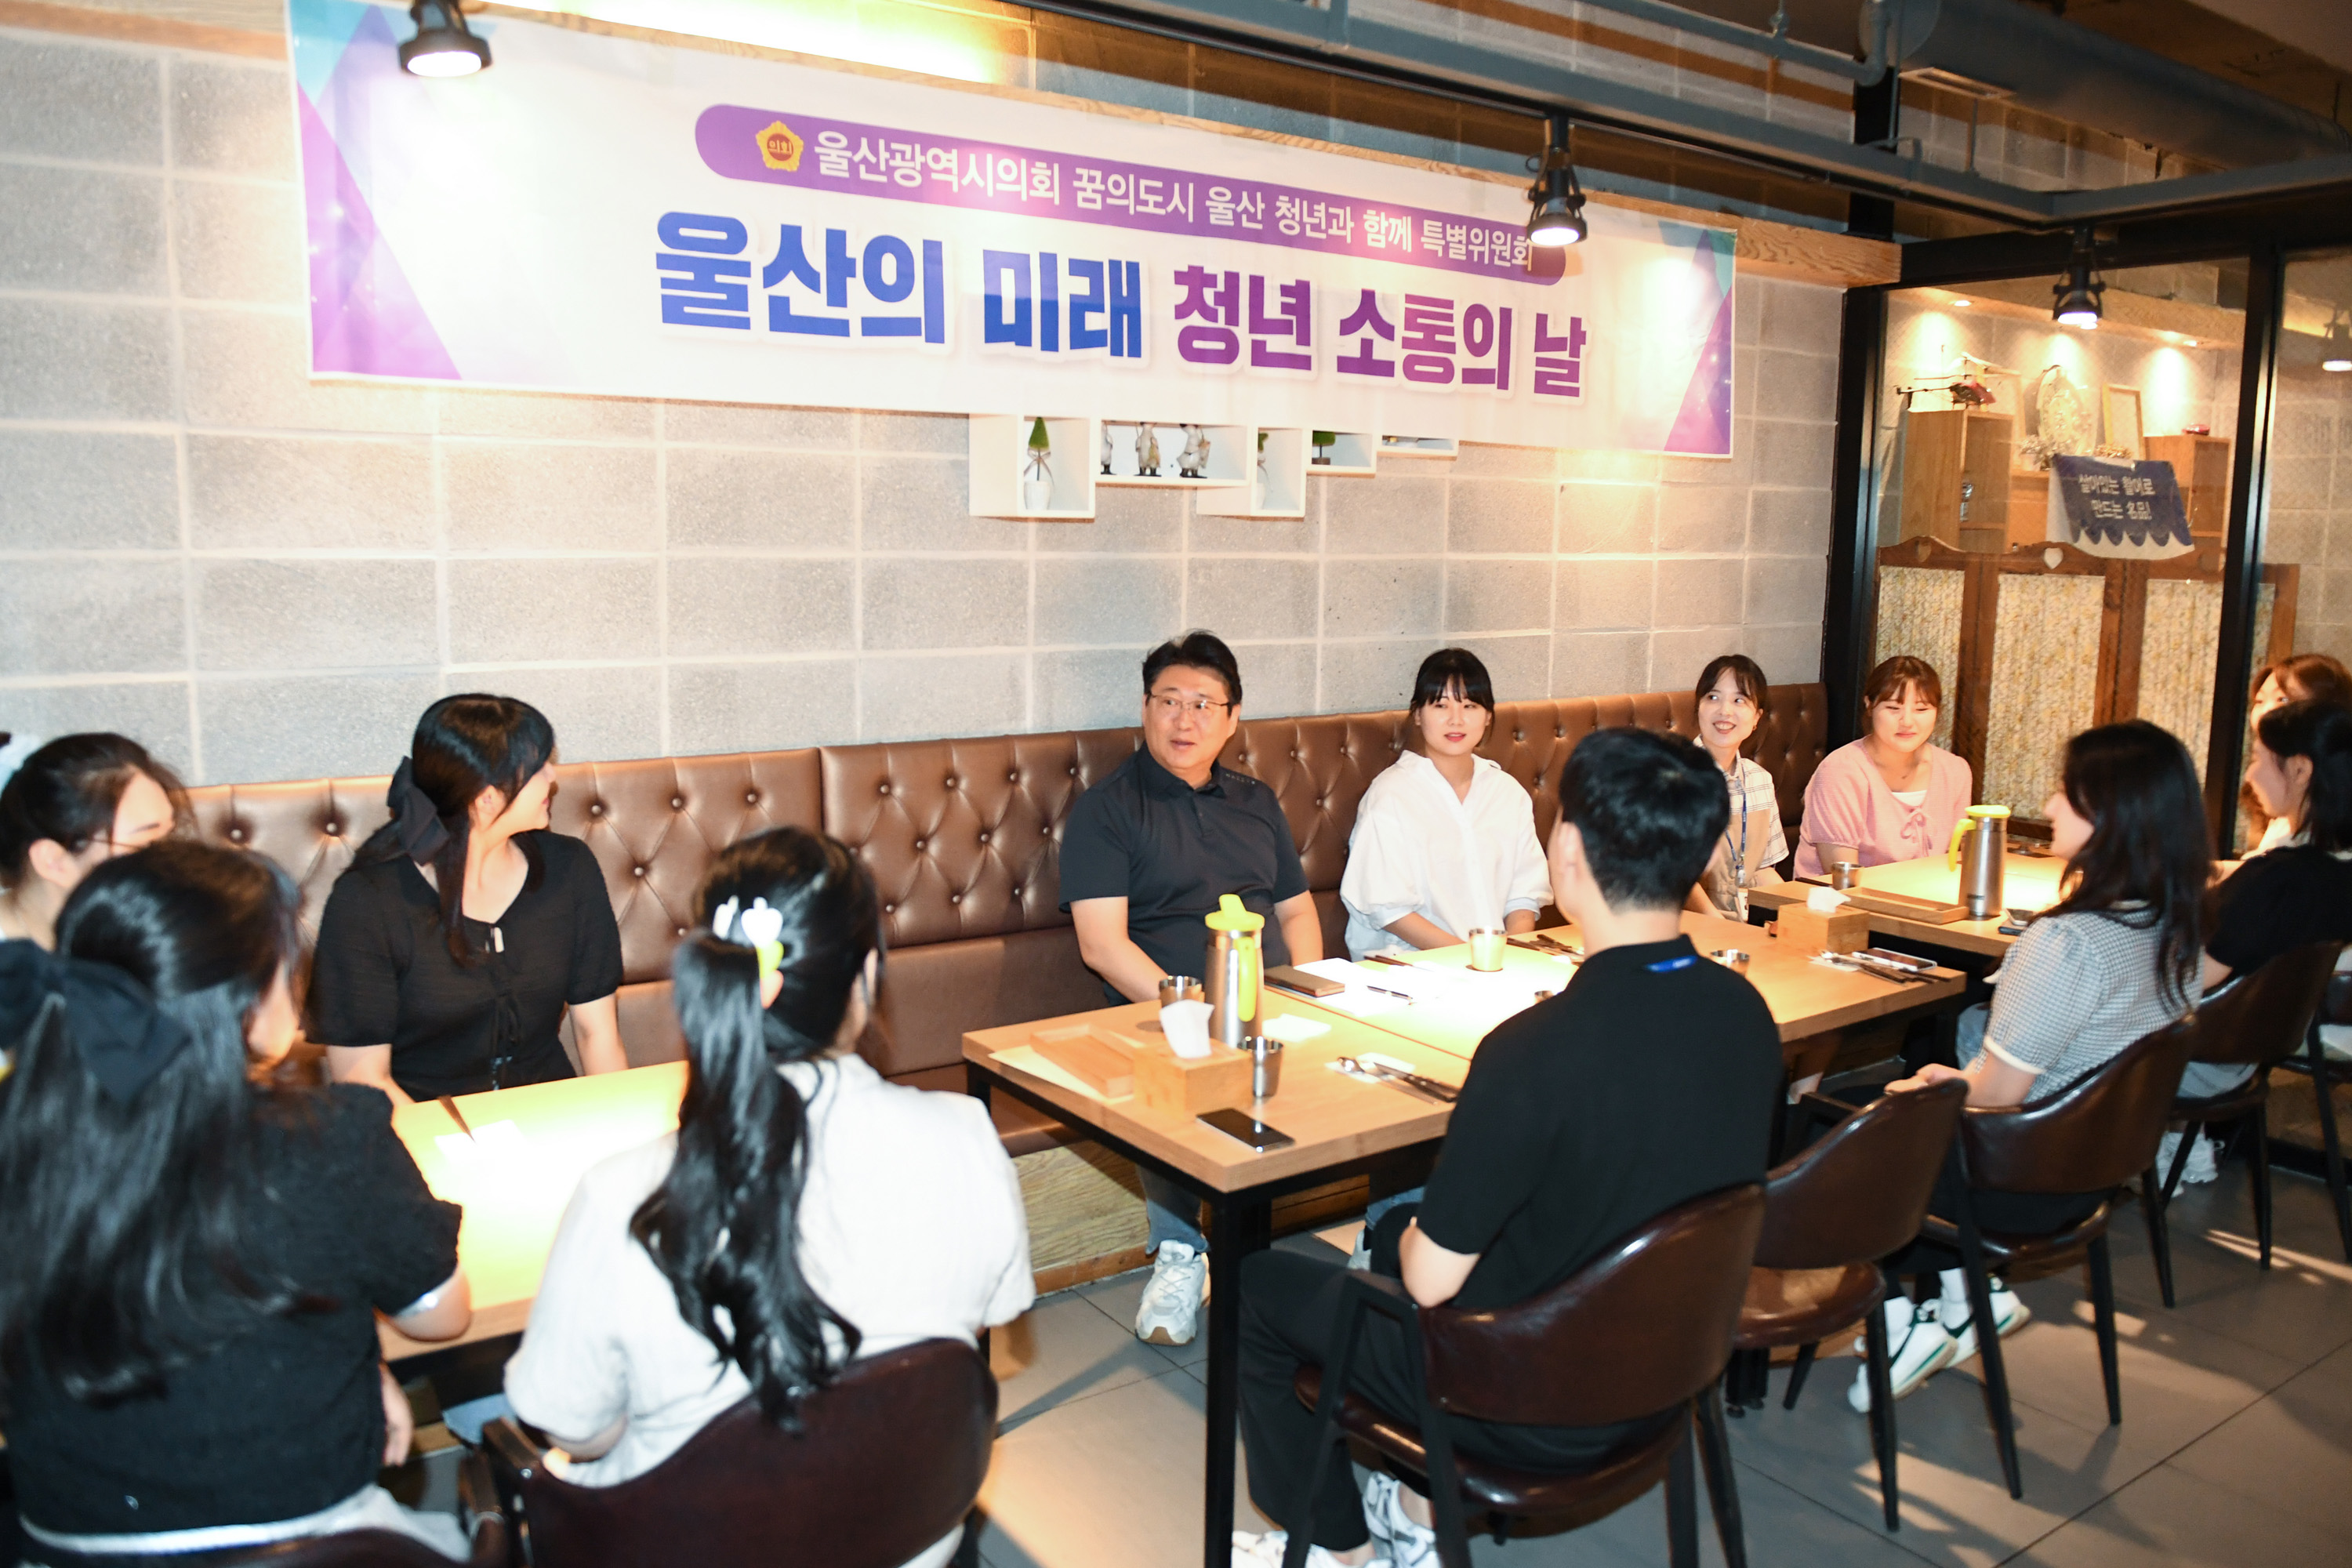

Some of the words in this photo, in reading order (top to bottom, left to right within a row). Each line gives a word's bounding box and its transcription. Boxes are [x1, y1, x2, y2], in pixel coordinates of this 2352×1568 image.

[768, 140, 793, 155] 의회
[815, 130, 1060, 205] 울산광역시의회
[1073, 167, 1194, 223] 꿈의도시
[1205, 186, 1265, 227] 울산
[1275, 194, 1354, 243] 청년과
[1363, 209, 1413, 252] 함께
[1421, 220, 1533, 271] 특별위원회
[656, 212, 945, 343] 울산의
[983, 249, 1142, 358] 미래
[1174, 264, 1312, 372] 청년
[1337, 289, 1512, 390] 소통의
[1534, 313, 1586, 397] 날
[2091, 499, 2124, 519] 만드는
